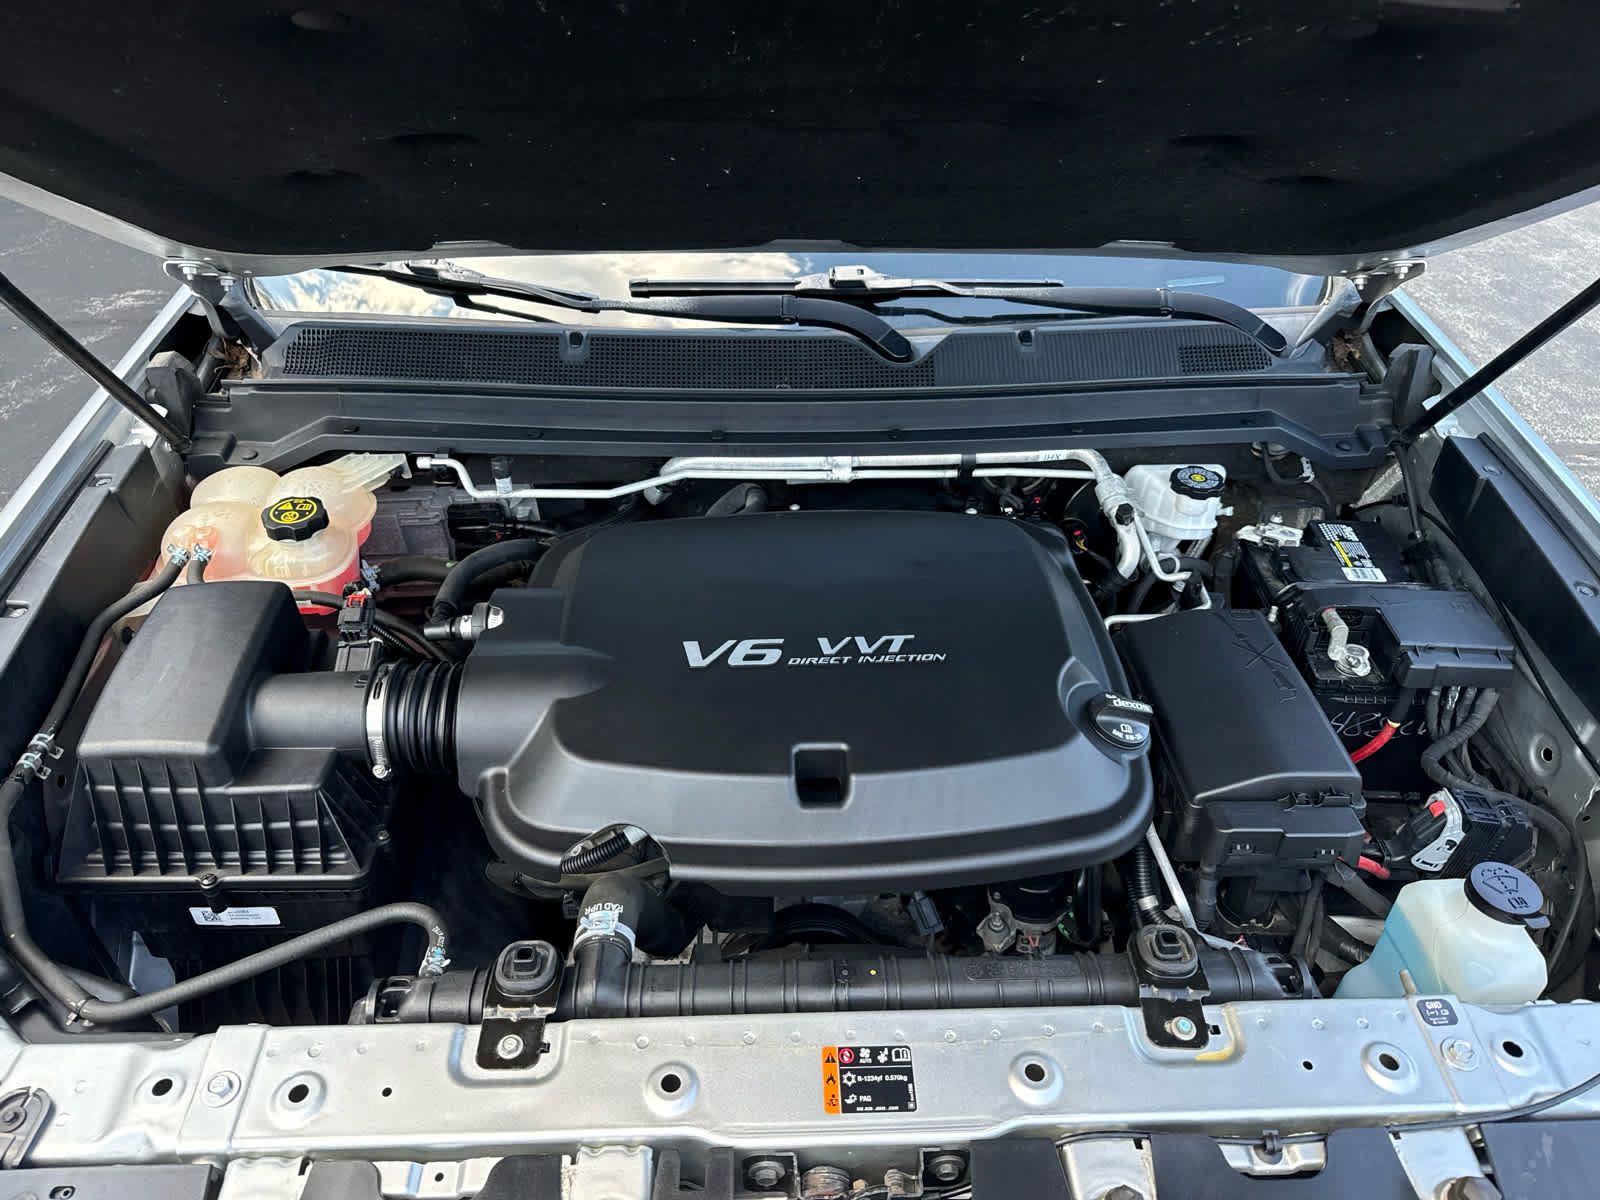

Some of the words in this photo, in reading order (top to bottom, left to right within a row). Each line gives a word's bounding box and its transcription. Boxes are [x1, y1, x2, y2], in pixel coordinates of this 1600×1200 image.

[682, 638, 785, 668] V6
[817, 634, 916, 656] VVT
[787, 656, 853, 666] DIRECT
[857, 653, 947, 665] INJECTION
